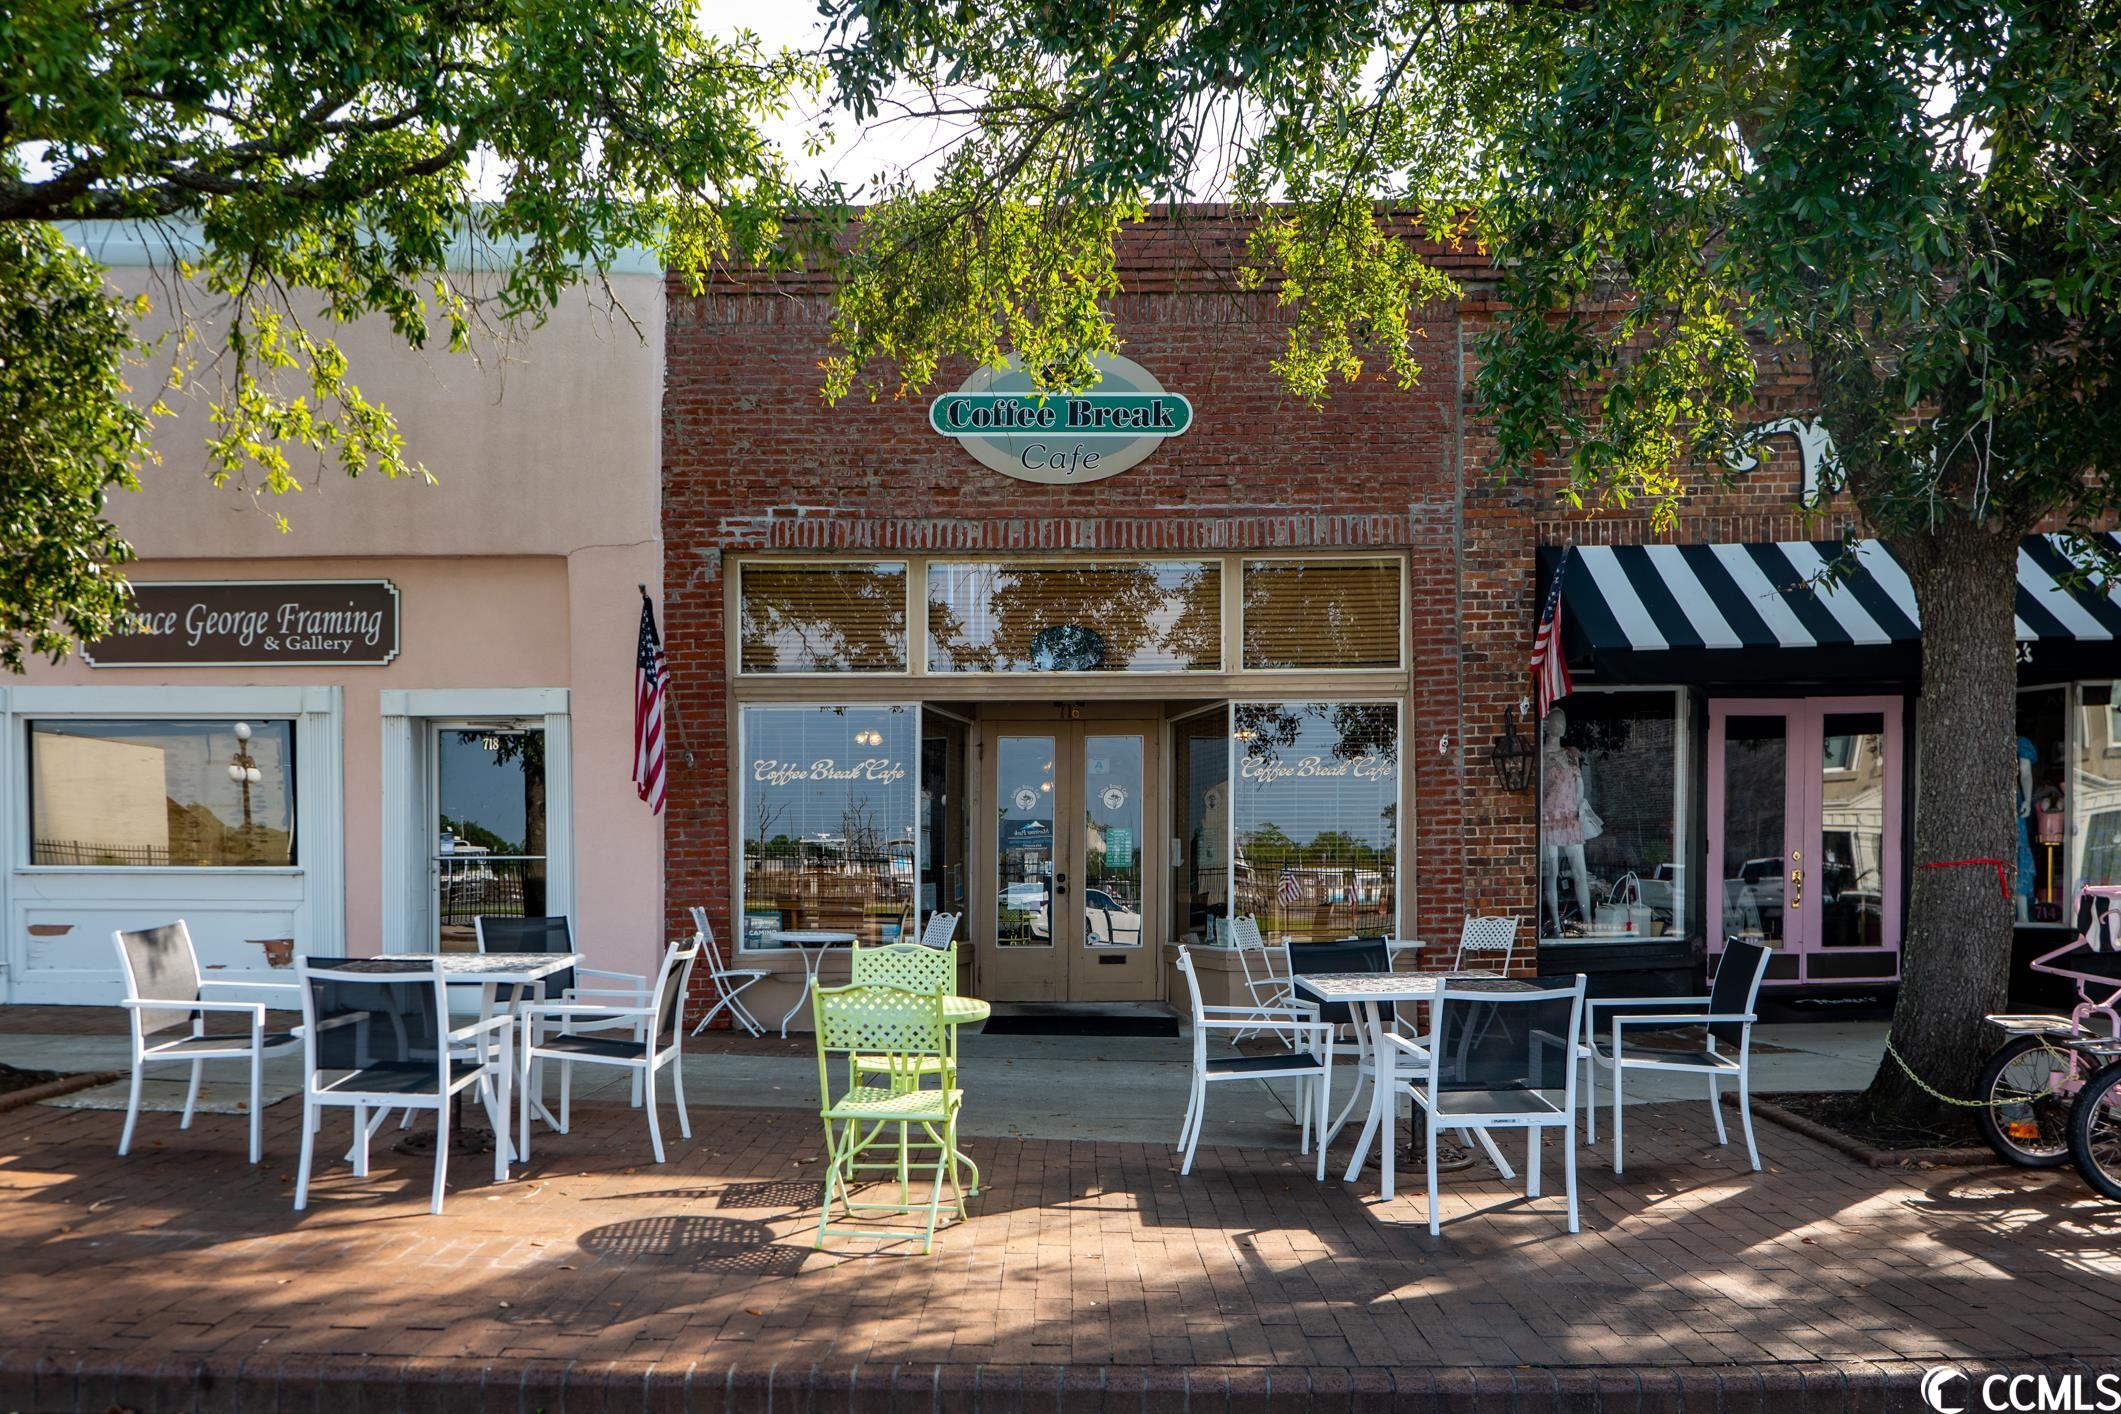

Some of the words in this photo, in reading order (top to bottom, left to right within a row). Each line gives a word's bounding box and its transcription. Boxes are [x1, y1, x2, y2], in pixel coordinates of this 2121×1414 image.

[947, 398, 1056, 428] Coffee
[1065, 399, 1176, 429] Break
[1021, 443, 1101, 475] Cafe
[185, 603, 269, 647] George
[277, 600, 382, 646] Framing
[263, 636, 280, 651] &
[285, 636, 353, 654] Gallery
[483, 737, 499, 750] 718
[753, 759, 808, 786] Coffee
[810, 758, 865, 780] Break
[865, 758, 905, 785] Cafe
[1240, 756, 1295, 783] Coffee
[1296, 756, 1353, 777] Break
[1353, 755, 1392, 782] Cafe
